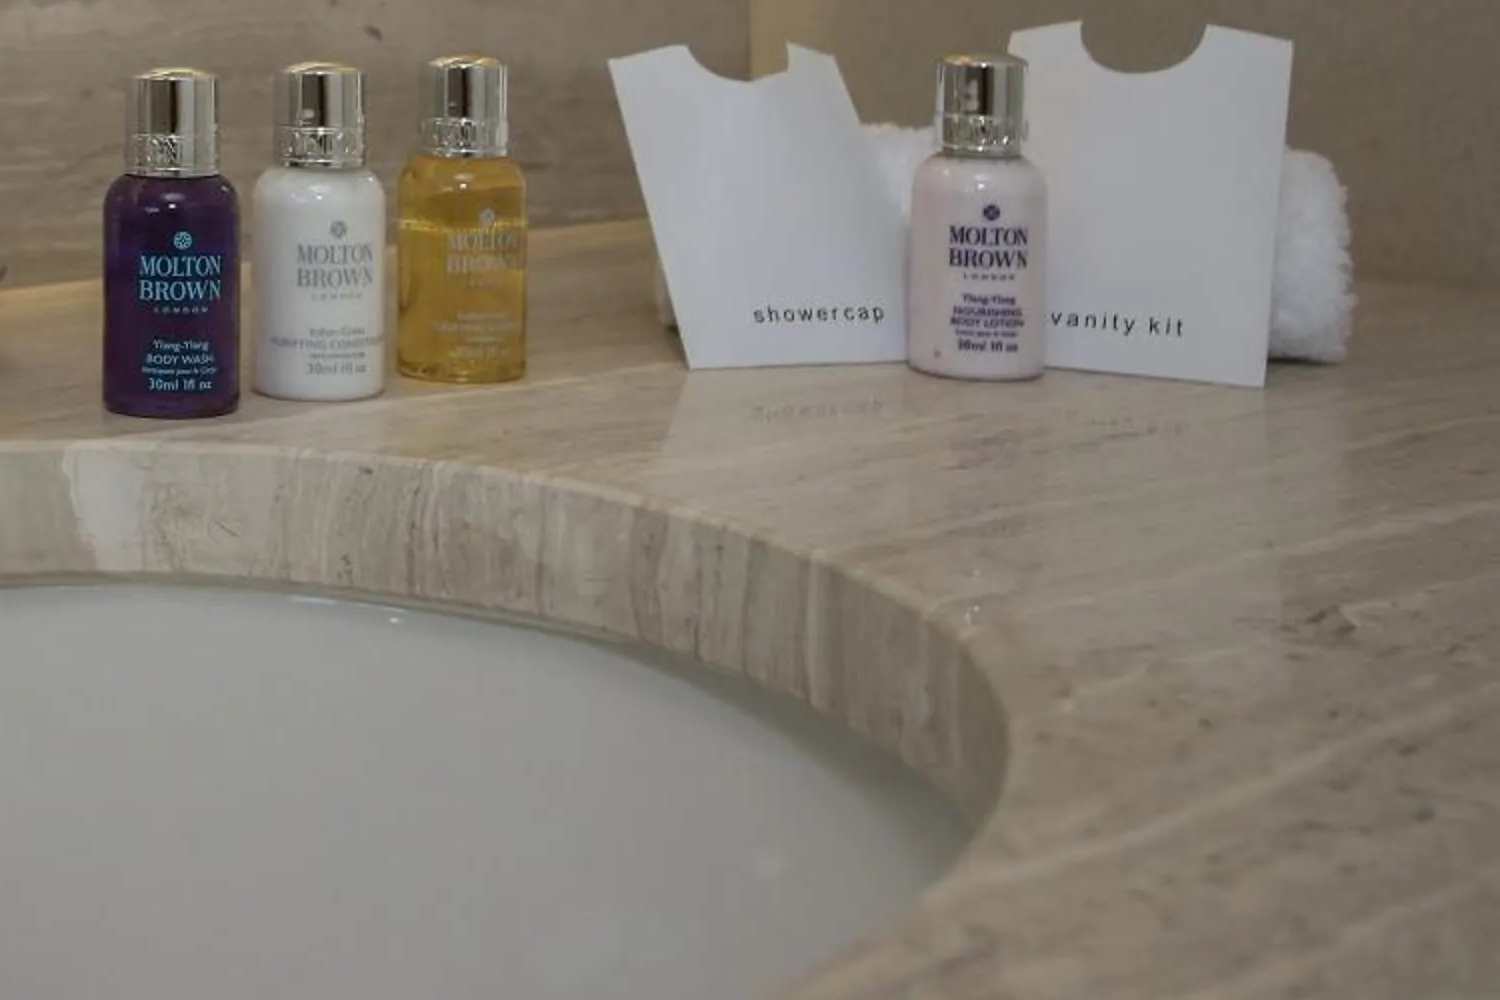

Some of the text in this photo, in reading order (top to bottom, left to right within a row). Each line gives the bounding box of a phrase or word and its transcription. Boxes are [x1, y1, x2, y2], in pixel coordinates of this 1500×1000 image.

[949, 225, 1028, 246] MOLTON
[296, 242, 373, 265] MOLTON
[949, 248, 1028, 269] BROWN
[140, 255, 221, 276] MOLTON
[296, 267, 373, 288] BROWN
[139, 279, 221, 300] BROWN
[753, 304, 885, 324] showercap
[1050, 311, 1184, 337] vanity kit
[146, 353, 215, 365] BODY WASH
